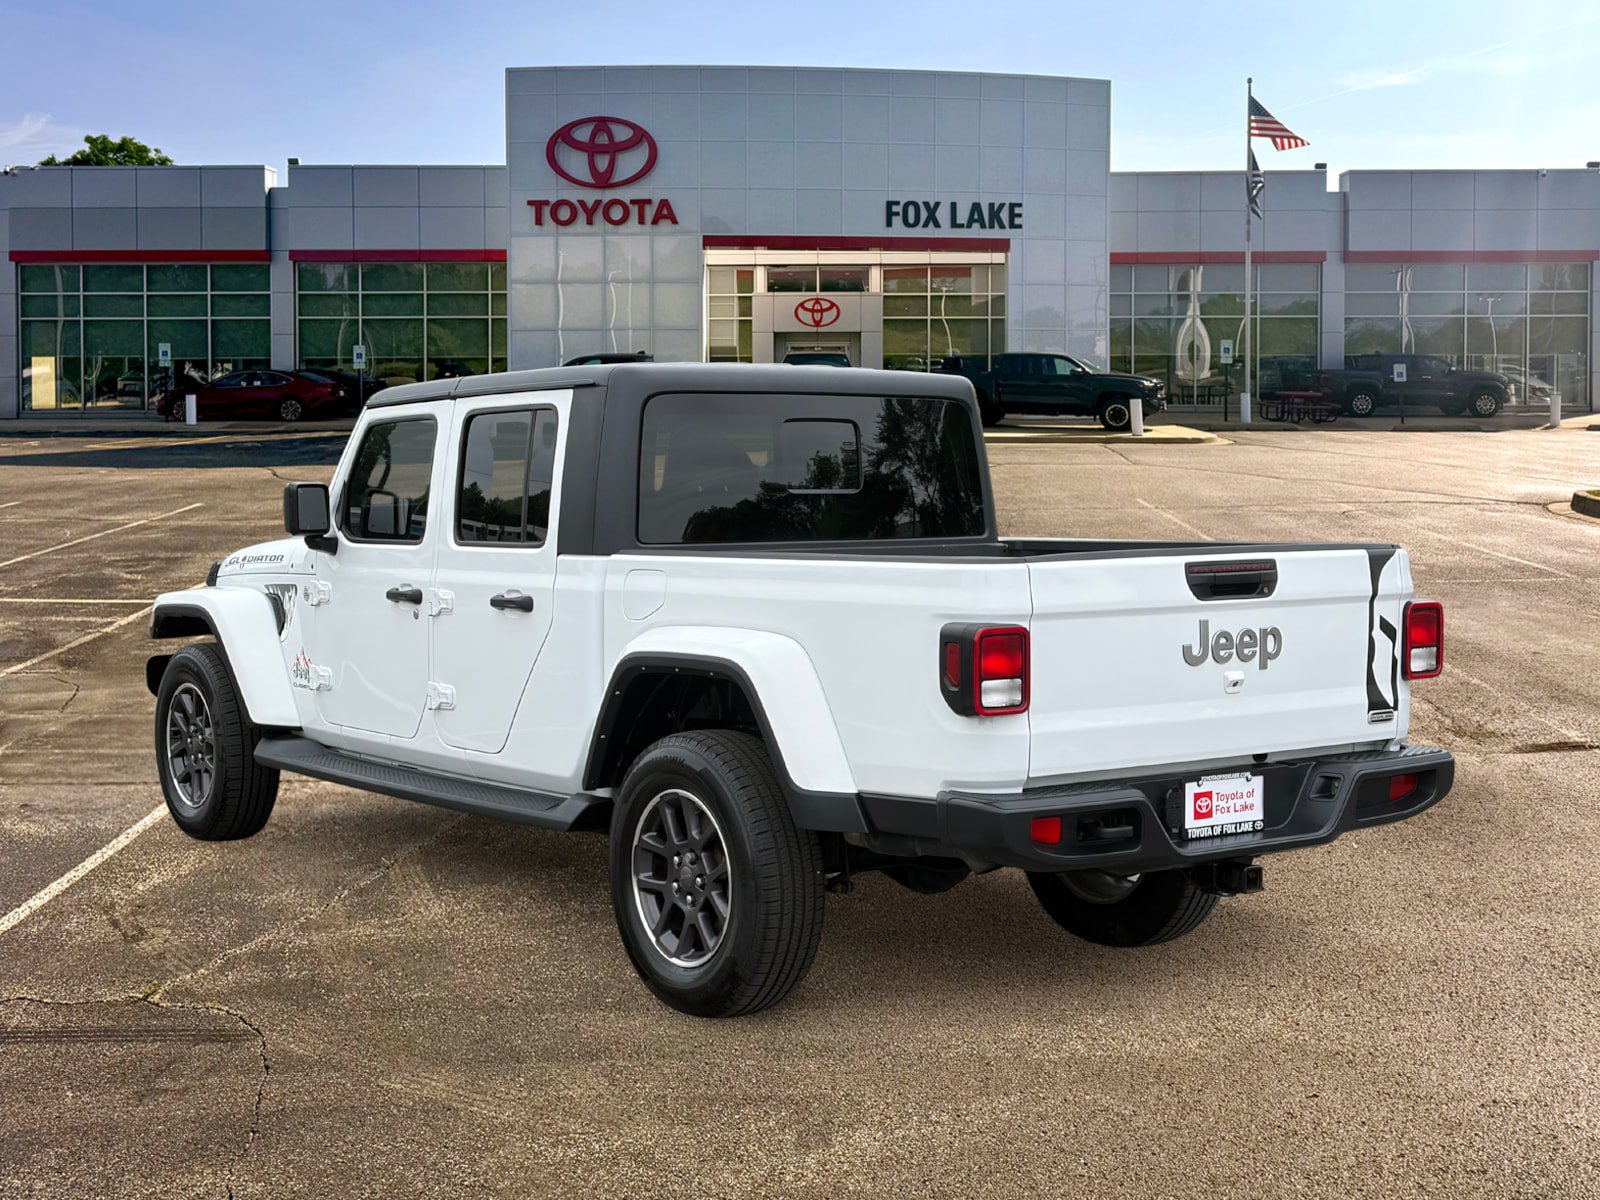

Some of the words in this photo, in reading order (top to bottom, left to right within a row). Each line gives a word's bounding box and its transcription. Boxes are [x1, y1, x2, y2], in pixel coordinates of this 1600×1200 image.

[527, 199, 679, 226] TOYOTA
[885, 201, 942, 228] FOX
[950, 201, 1023, 229] LAKE
[229, 555, 285, 566] GLADIATOR
[1182, 619, 1283, 671] Jeep
[1215, 790, 1244, 803] Toyota
[1246, 788, 1255, 798] of
[1215, 804, 1231, 815] Fox
[1234, 801, 1255, 812] Lake
[1187, 828, 1213, 839] TOYOTA
[1213, 826, 1222, 836] OF
[1223, 824, 1236, 834] FOX
[1236, 822, 1253, 832] LAKE
